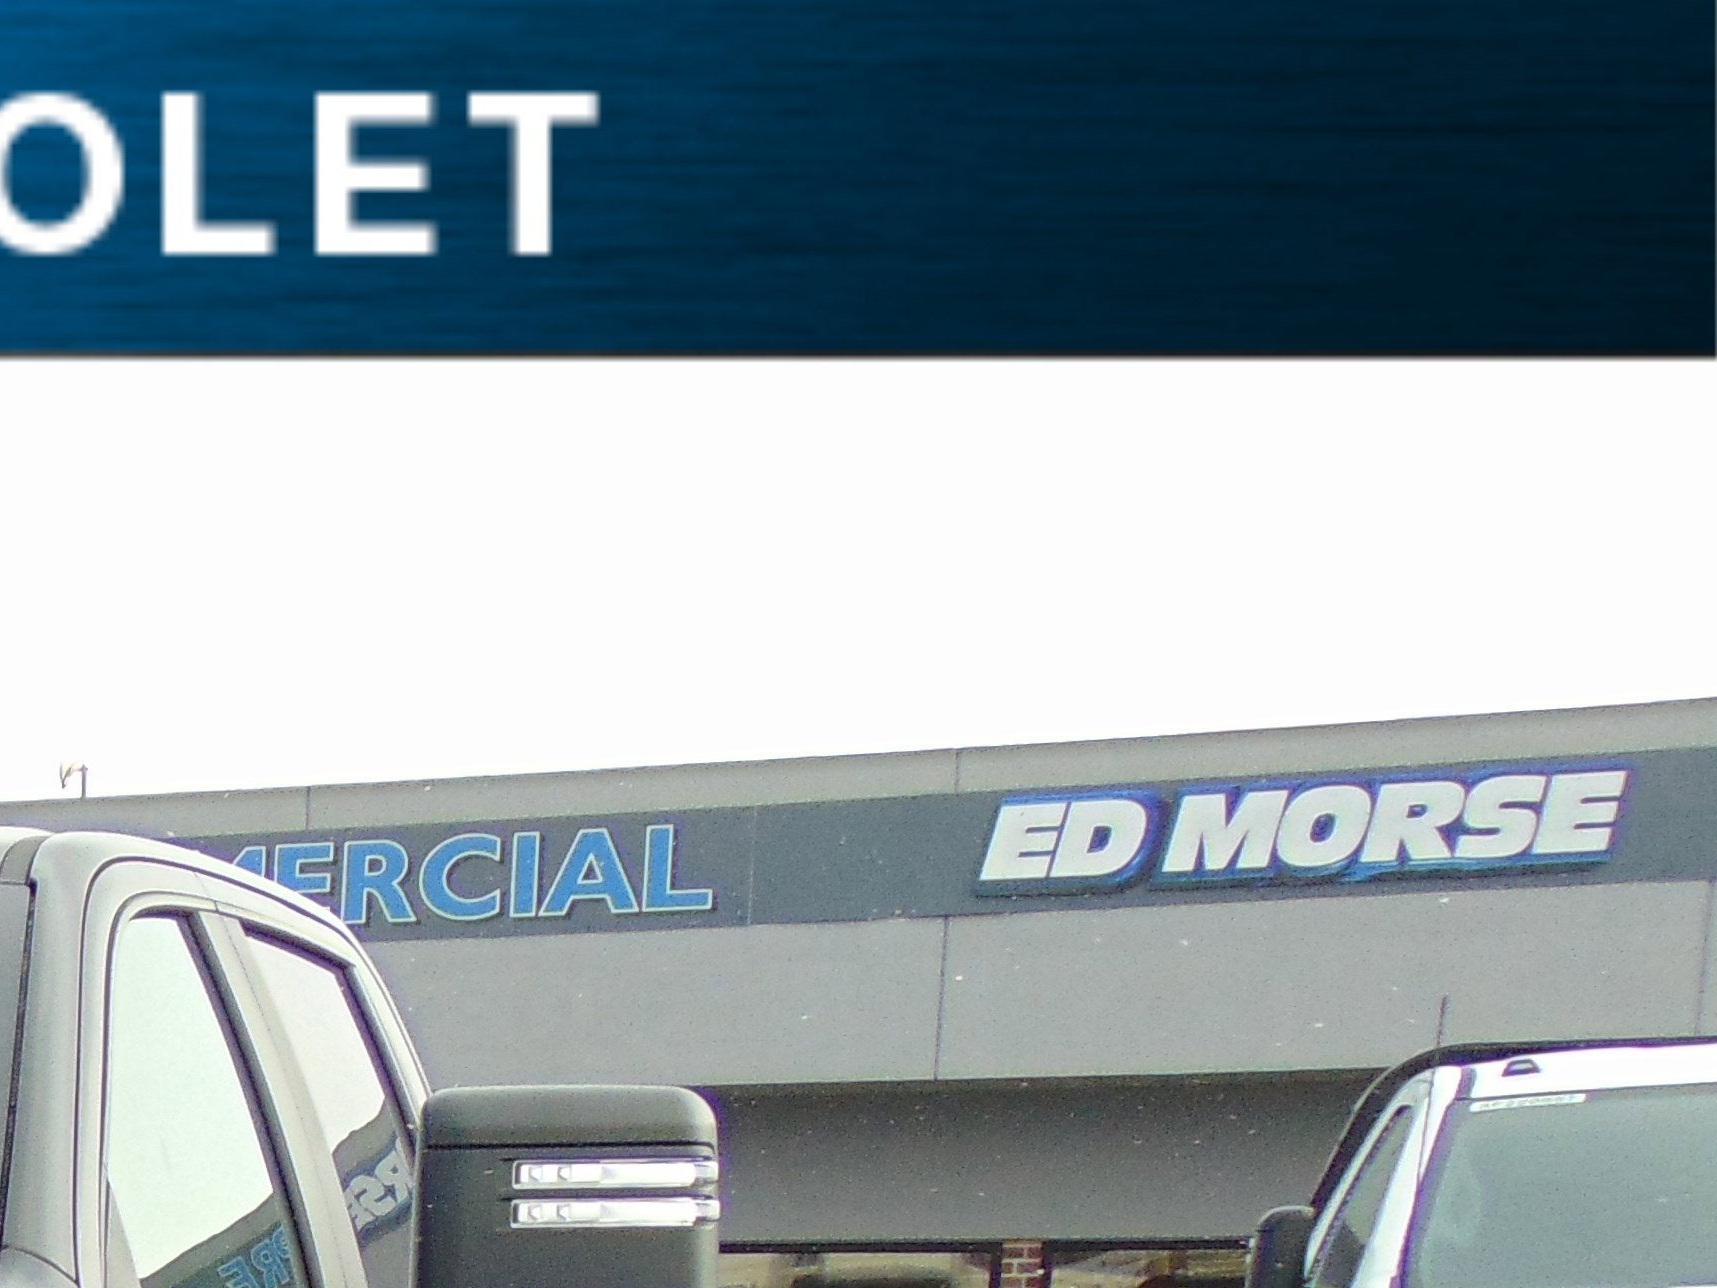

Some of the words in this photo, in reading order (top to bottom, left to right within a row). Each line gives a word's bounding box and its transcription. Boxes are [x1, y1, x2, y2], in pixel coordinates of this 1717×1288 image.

[233, 822, 715, 925] ERCIAL
[979, 798, 1148, 882] ED
[1160, 770, 1629, 874] MORSE
